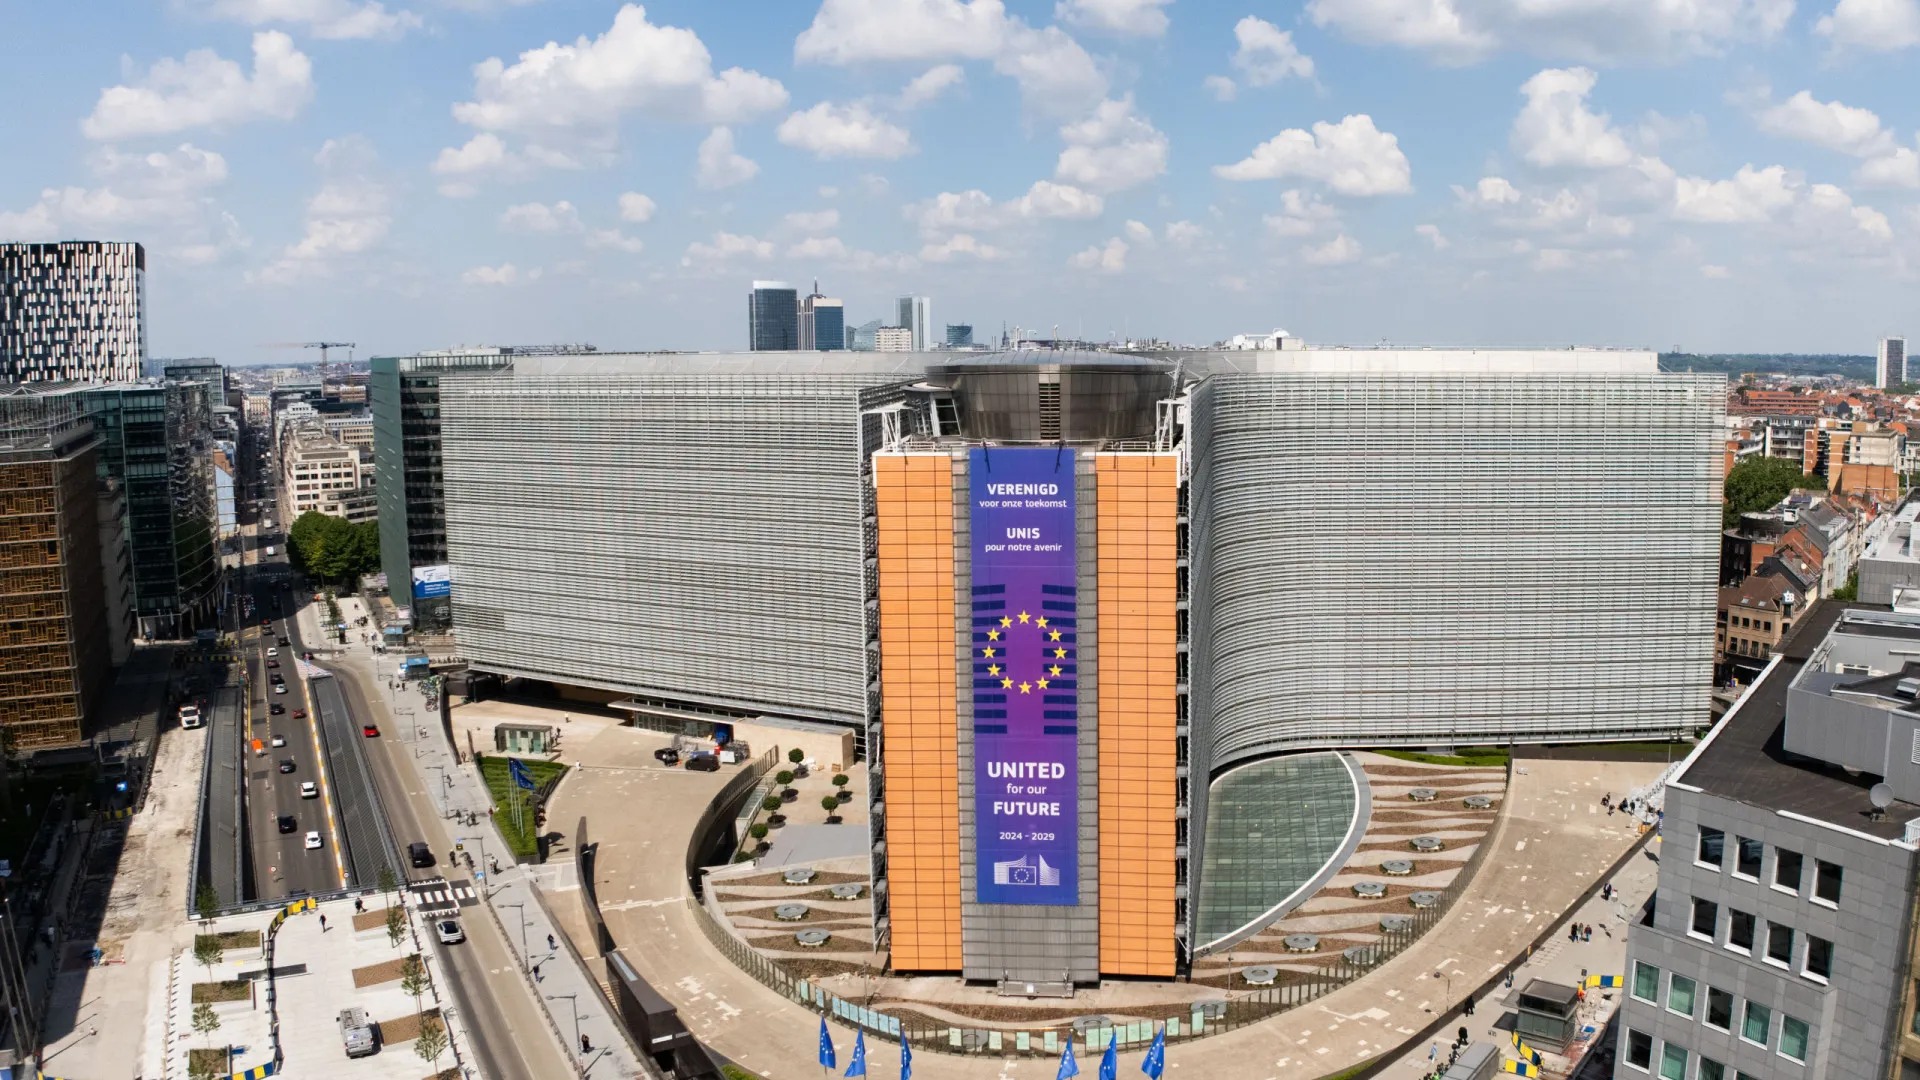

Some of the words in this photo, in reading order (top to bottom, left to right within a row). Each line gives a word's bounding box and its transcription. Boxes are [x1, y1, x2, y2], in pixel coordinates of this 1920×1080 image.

[986, 483, 1059, 495] VERENIGD
[979, 500, 1000, 508] voor
[1001, 500, 1023, 508] onze
[1025, 499, 1067, 508] toekomst
[1006, 527, 1041, 539] UNIS
[985, 544, 1006, 553] pour
[1007, 543, 1032, 551] notre
[1034, 543, 1063, 551] avenir
[987, 761, 1066, 779] UNITED
[1006, 783, 1023, 794] for
[1027, 785, 1047, 794] our
[993, 801, 1060, 816] FUTURE
[999, 832, 1023, 840] 2024
[1031, 832, 1055, 841] 2029
